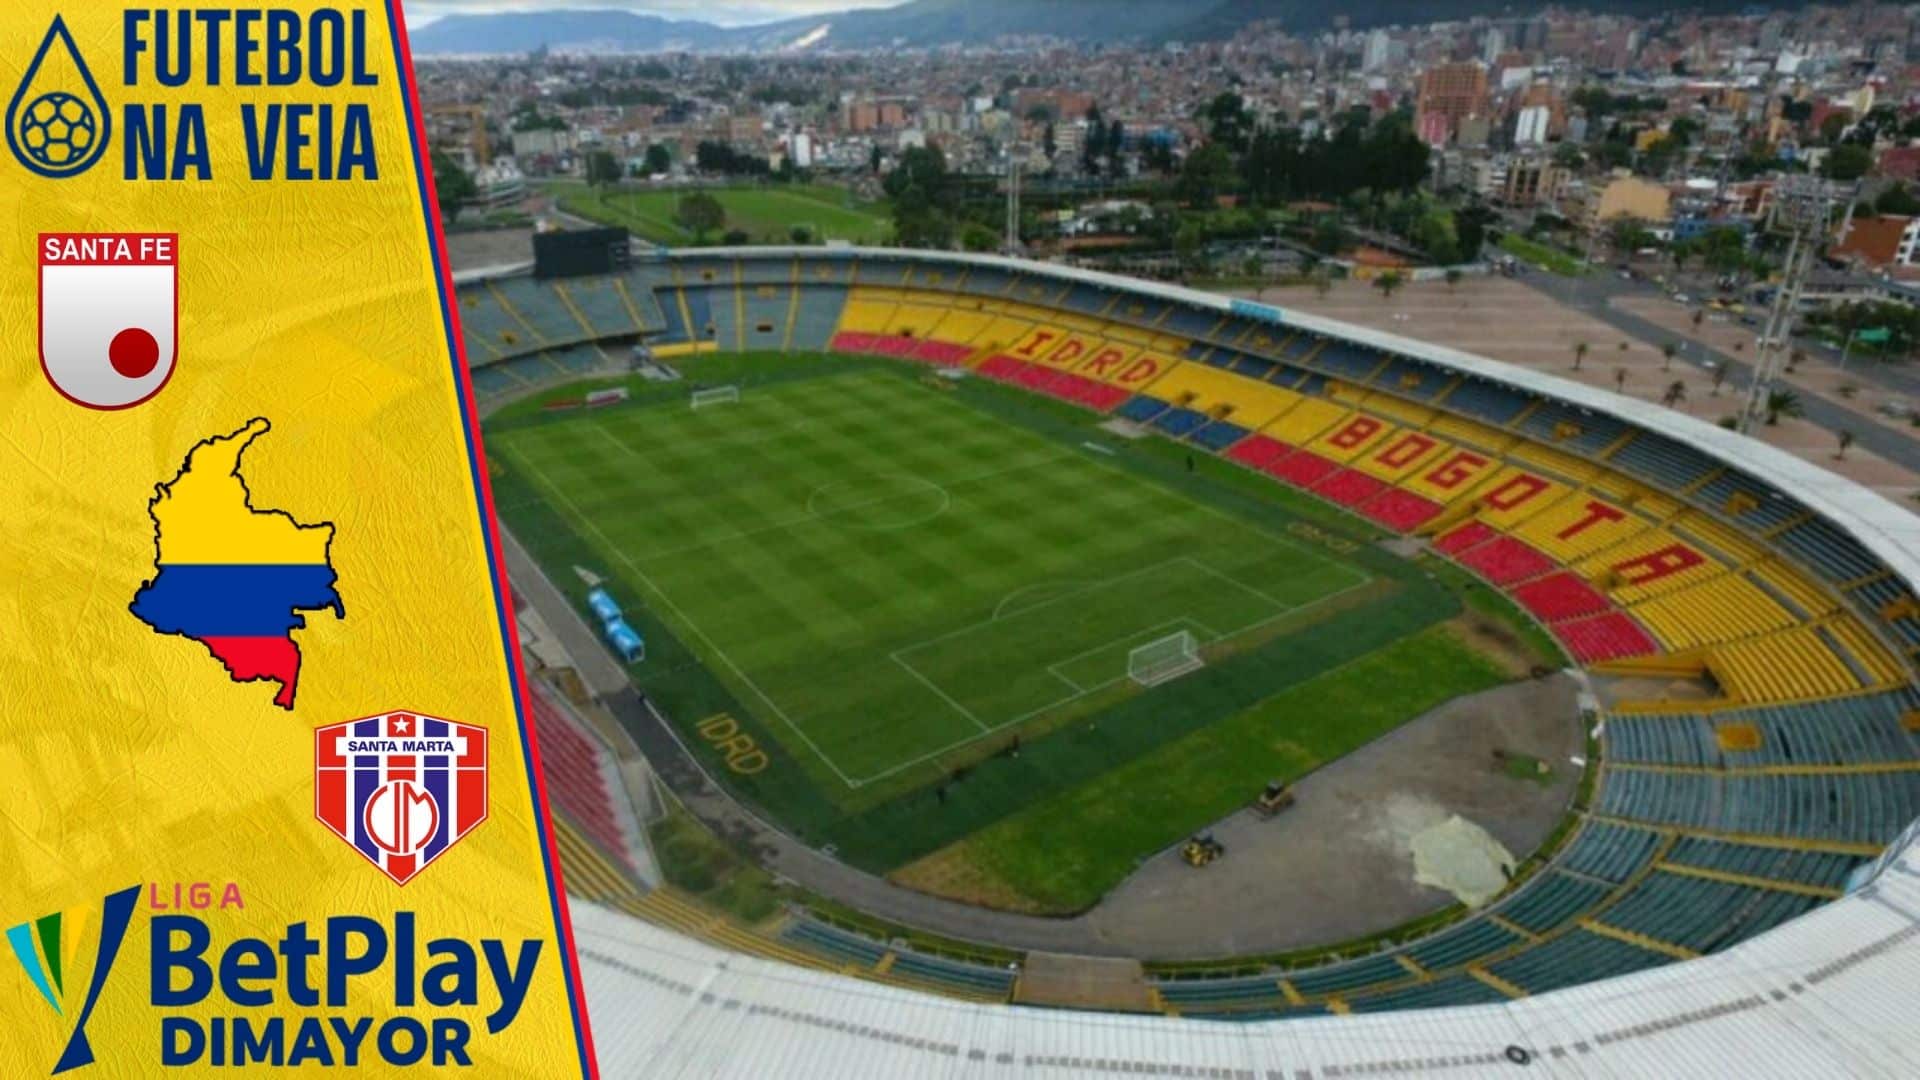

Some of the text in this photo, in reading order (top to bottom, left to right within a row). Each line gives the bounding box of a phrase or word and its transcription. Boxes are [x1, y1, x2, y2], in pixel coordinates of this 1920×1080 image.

[1014, 331, 1159, 385] IDRD
[1327, 414, 1708, 585] BOGOTA
[695, 712, 769, 774] IDRD
